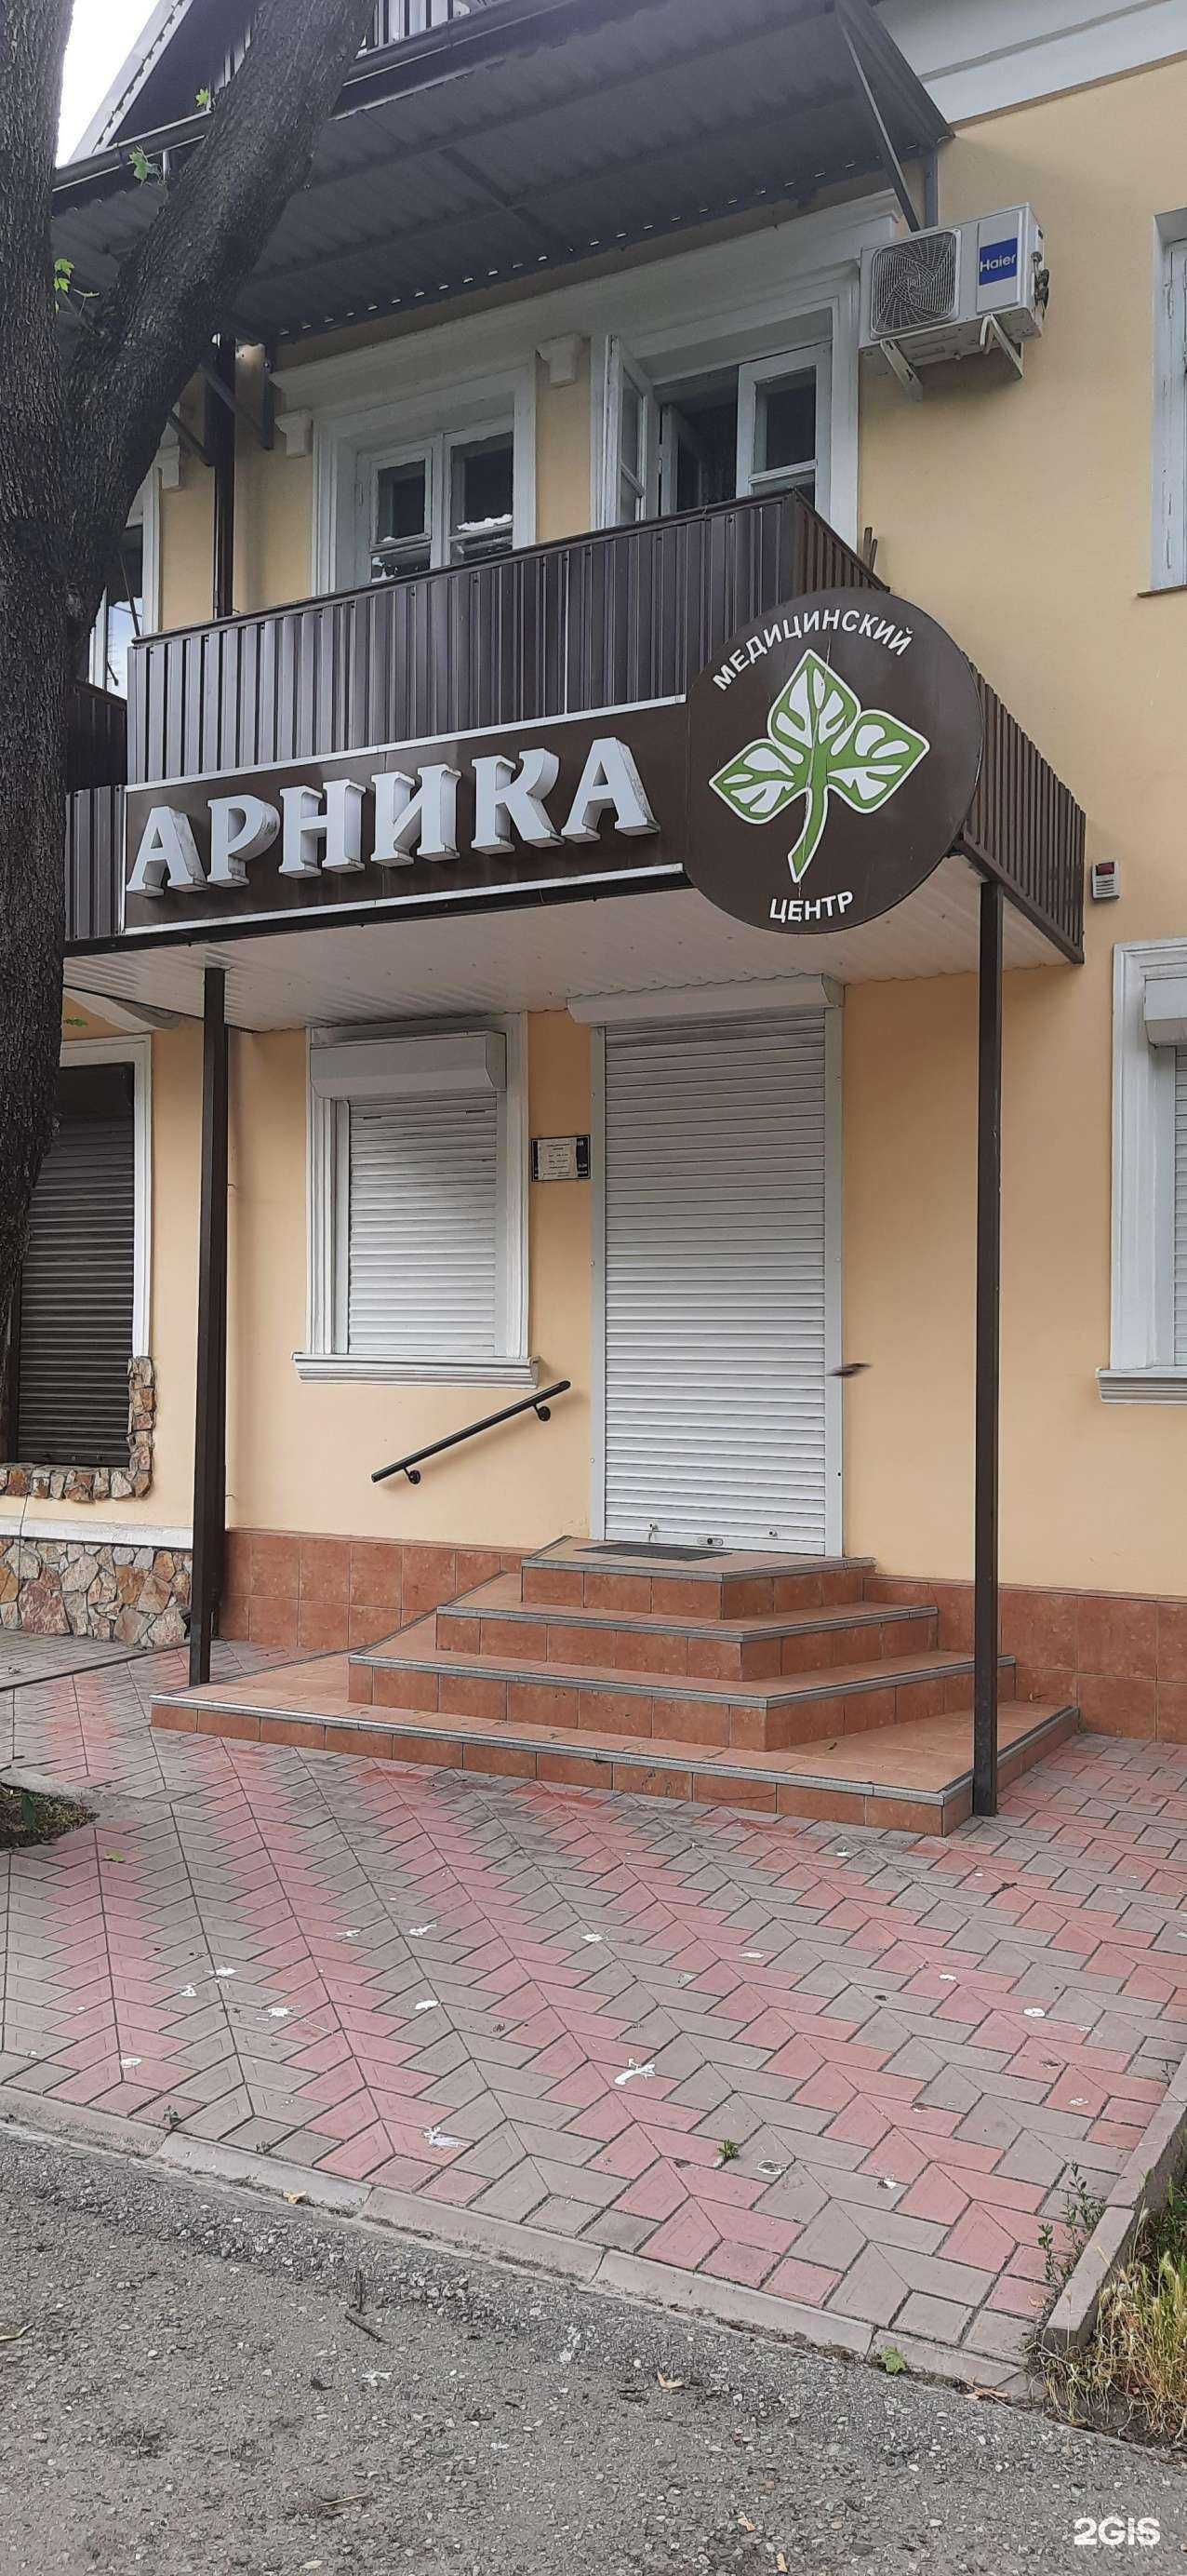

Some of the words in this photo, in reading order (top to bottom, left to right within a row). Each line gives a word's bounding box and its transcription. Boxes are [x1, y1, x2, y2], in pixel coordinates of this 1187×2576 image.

[980, 253, 1018, 273] Haier
[713, 609, 914, 691] МЕДИЦИНСКИЙ
[127, 736, 660, 897] АРНИКА
[769, 891, 854, 923] ЦЕНТР
